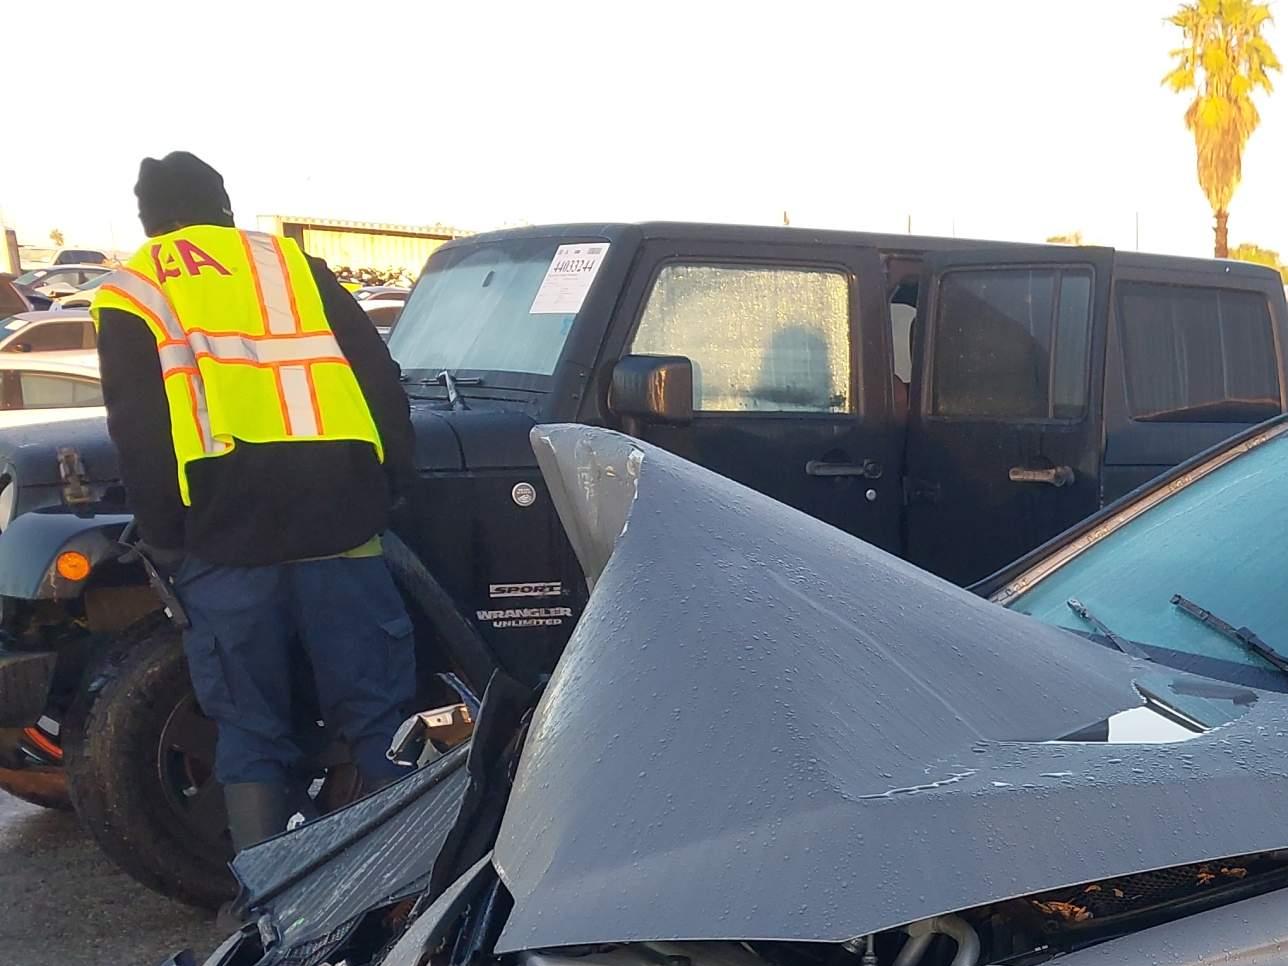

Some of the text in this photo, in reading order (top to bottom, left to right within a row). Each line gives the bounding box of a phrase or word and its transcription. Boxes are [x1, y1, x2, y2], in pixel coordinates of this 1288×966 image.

[493, 584, 562, 594] SPORT
[476, 607, 573, 621] WRANGLER
[492, 618, 563, 628] UNLIMITED
